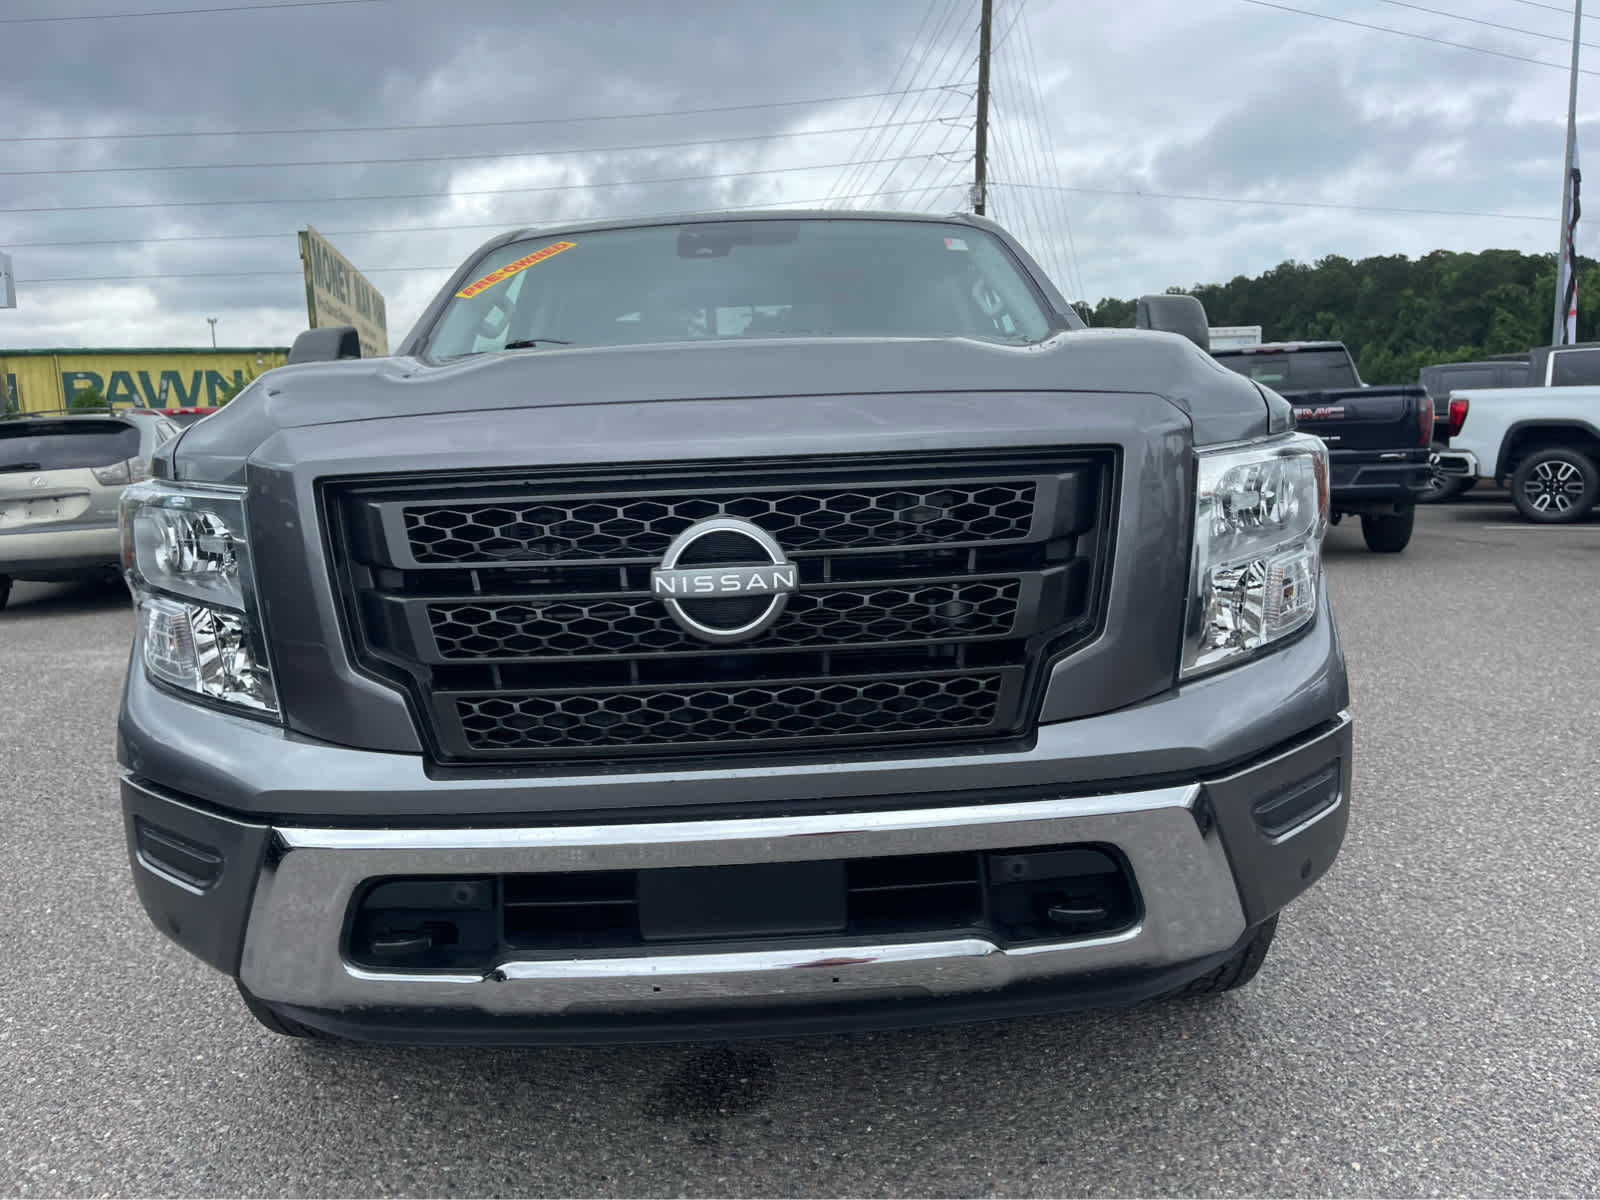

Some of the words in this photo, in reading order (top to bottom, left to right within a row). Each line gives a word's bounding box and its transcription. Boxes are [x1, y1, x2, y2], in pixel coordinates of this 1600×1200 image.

[311, 237, 350, 307] MONEY
[461, 242, 570, 297] PRE-OWNED
[61, 369, 244, 410] PAWN
[655, 570, 795, 593] NISSAN
